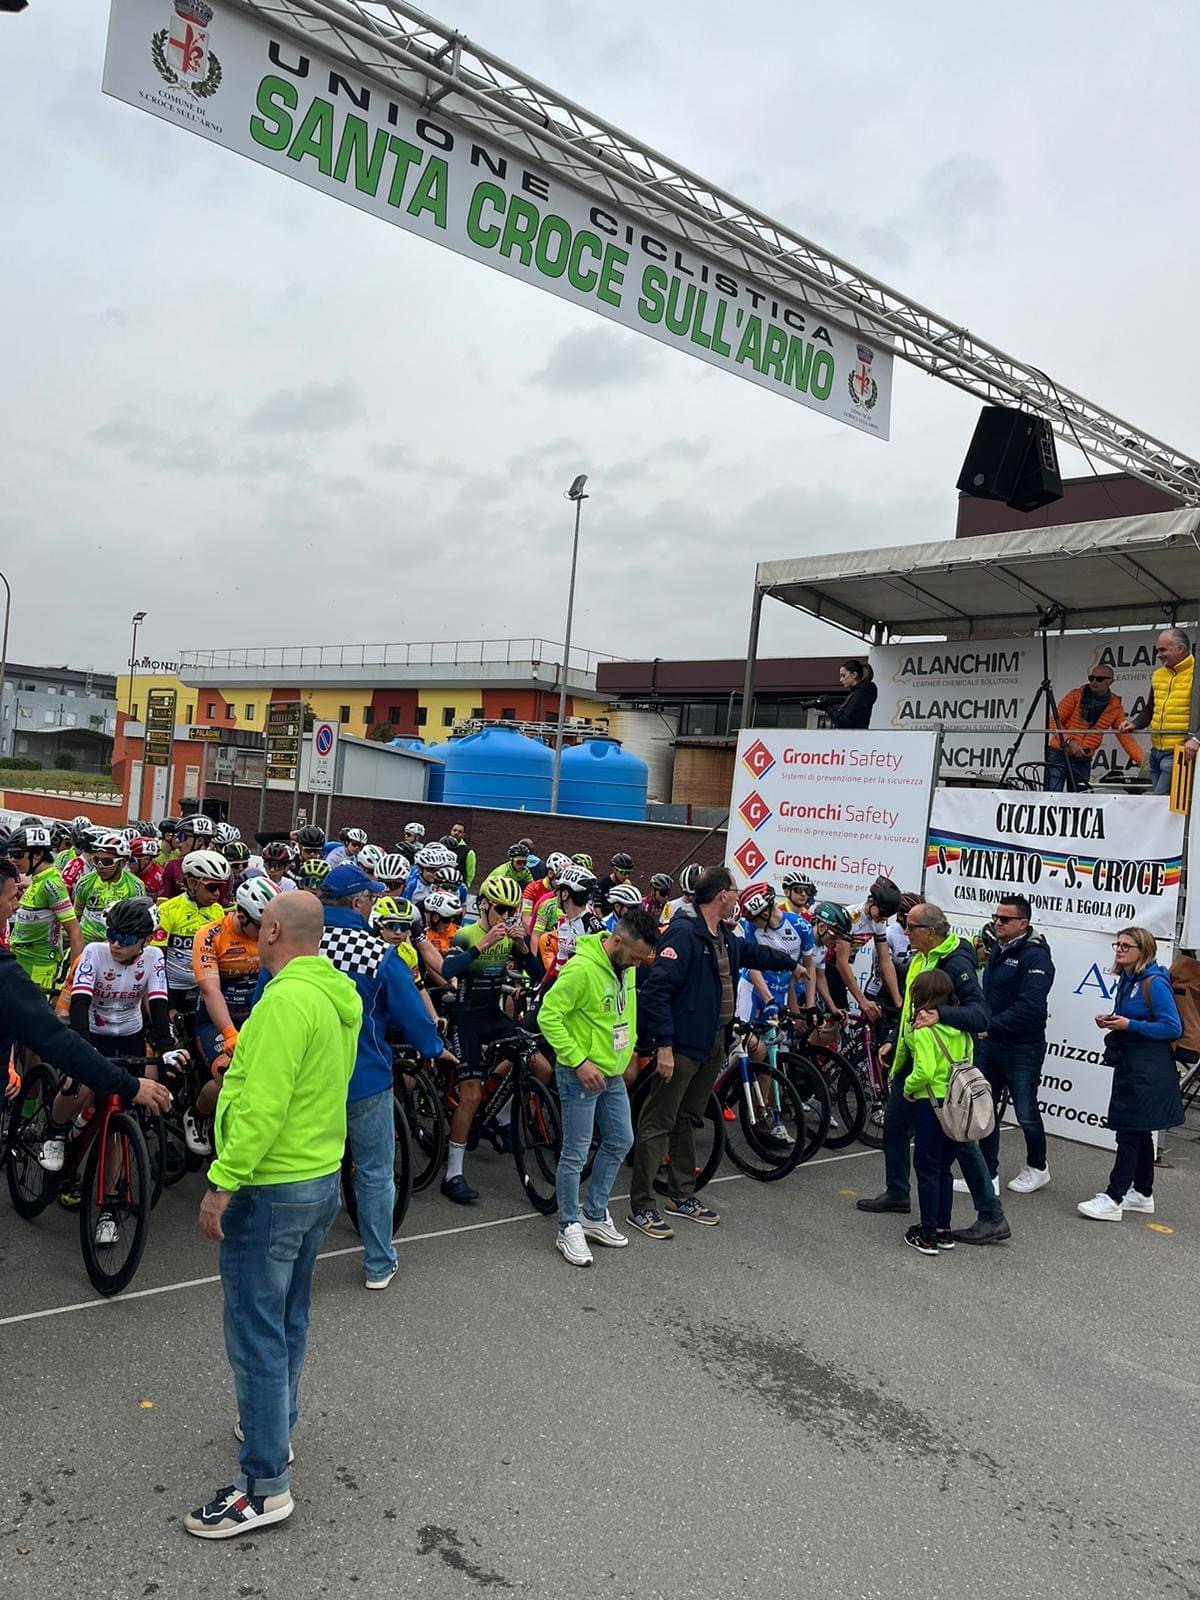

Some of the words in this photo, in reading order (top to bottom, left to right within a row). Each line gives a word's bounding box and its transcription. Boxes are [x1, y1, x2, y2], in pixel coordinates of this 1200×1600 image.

[158, 89, 196, 112] COMUNE
[196, 106, 206, 116] DI
[268, 39, 550, 202] UNIONE
[589, 206, 835, 348] CICLISTICA
[249, 74, 449, 230] SANTA
[467, 181, 629, 308] CROCE
[637, 264, 835, 401] SULL'ARNO
[901, 651, 1020, 676] ALANCHIM
[912, 680, 941, 688] LEATHER
[942, 679, 979, 687] CHEMICALS
[980, 677, 1018, 686] SOLUTIONS
[1116, 673, 1148, 681] EATHER
[899, 698, 1018, 720] ALANCHIM
[783, 748, 846, 766] Gronchi
[849, 749, 903, 771] Safety
[781, 772, 807, 781] Sistemi
[807, 773, 816, 781] di
[816, 775, 862, 785] prevenzione
[863, 777, 877, 785] per
[878, 776, 885, 784] la
[886, 777, 923, 786] sicurezza
[197, 820, 209, 831] 92
[779, 801, 842, 821] Gronchi
[845, 804, 899, 829] Safety
[996, 802, 1106, 840] CICLISTICA
[31, 829, 46, 841] 76
[777, 825, 803, 834] Sistemi
[812, 829, 859, 839] prevenzione
[859, 832, 873, 841] per
[874, 831, 882, 840] la
[883, 834, 920, 844] sicurezza
[774, 849, 838, 872] Gronchi
[840, 855, 894, 877] Safety
[937, 846, 952, 875] S.
[959, 847, 1042, 885] MINIATO
[1065, 856, 1083, 889] S.
[1092, 858, 1166, 896] CROCE
[563, 868, 579, 882] 103
[811, 879, 854, 890] revenzione
[855, 883, 869, 892] per
[431, 895, 444, 907] 58
[748, 897, 764, 912] 52
[954, 885, 977, 901] CASA
[1029, 894, 1063, 912] PONTE
[1065, 898, 1073, 912] A
[1077, 901, 1112, 918] EGOLA
[1114, 906, 1136, 920] (PI)
